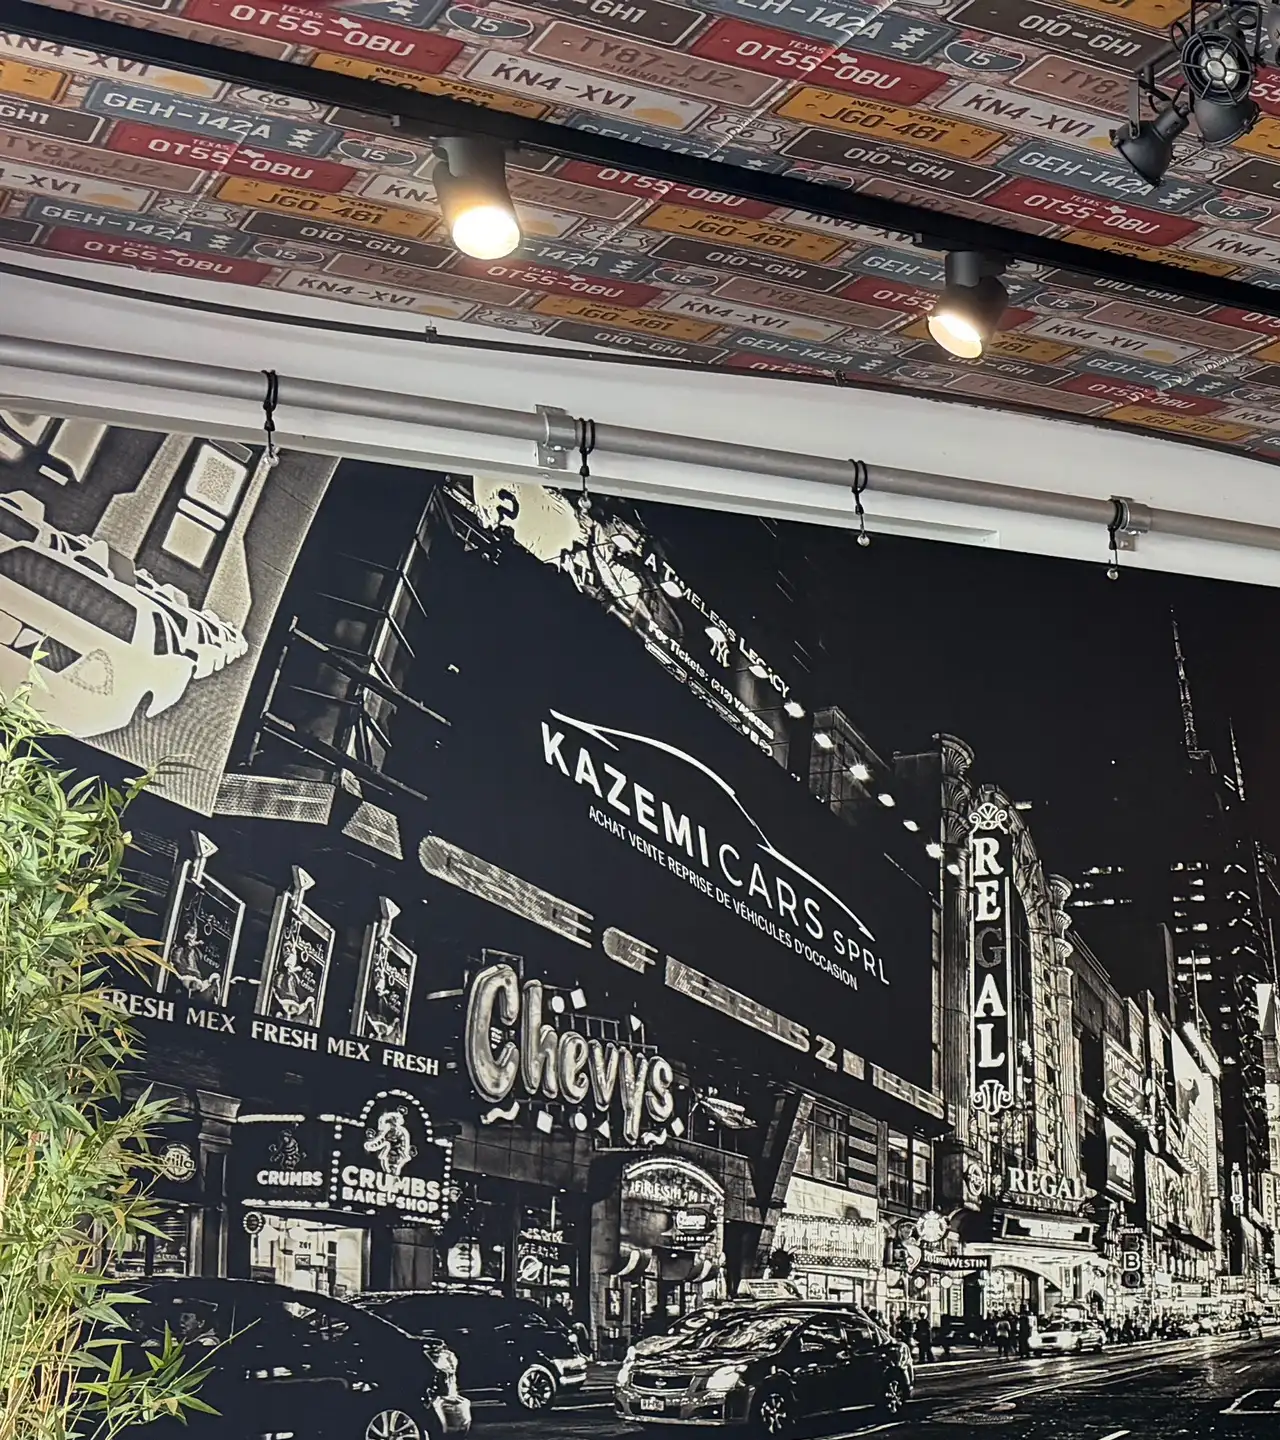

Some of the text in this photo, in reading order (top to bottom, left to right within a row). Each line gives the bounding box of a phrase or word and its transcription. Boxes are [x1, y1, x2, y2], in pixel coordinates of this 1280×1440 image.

[851, 100, 897, 115] NEW
[644, 553, 657, 572] A
[541, 722, 889, 986] KAZEMI CARS SPRL
[589, 805, 858, 991] ACHAT VENTE REPRISE DE VÉHICULES D'OCCASION
[970, 837, 1007, 1068] REGAL
[185, 1007, 237, 1034] MEX
[251, 1020, 318, 1052] FRESH
[327, 1036, 370, 1062] MEX
[382, 1049, 439, 1076] FRESH
[465, 963, 673, 1146] Chevys
[257, 1170, 323, 1187] CRUMBS
[342, 1165, 441, 1200] CRUMBS
[342, 1187, 439, 1213] BAKE SHOP
[948, 1259, 987, 1268] WESTIN
